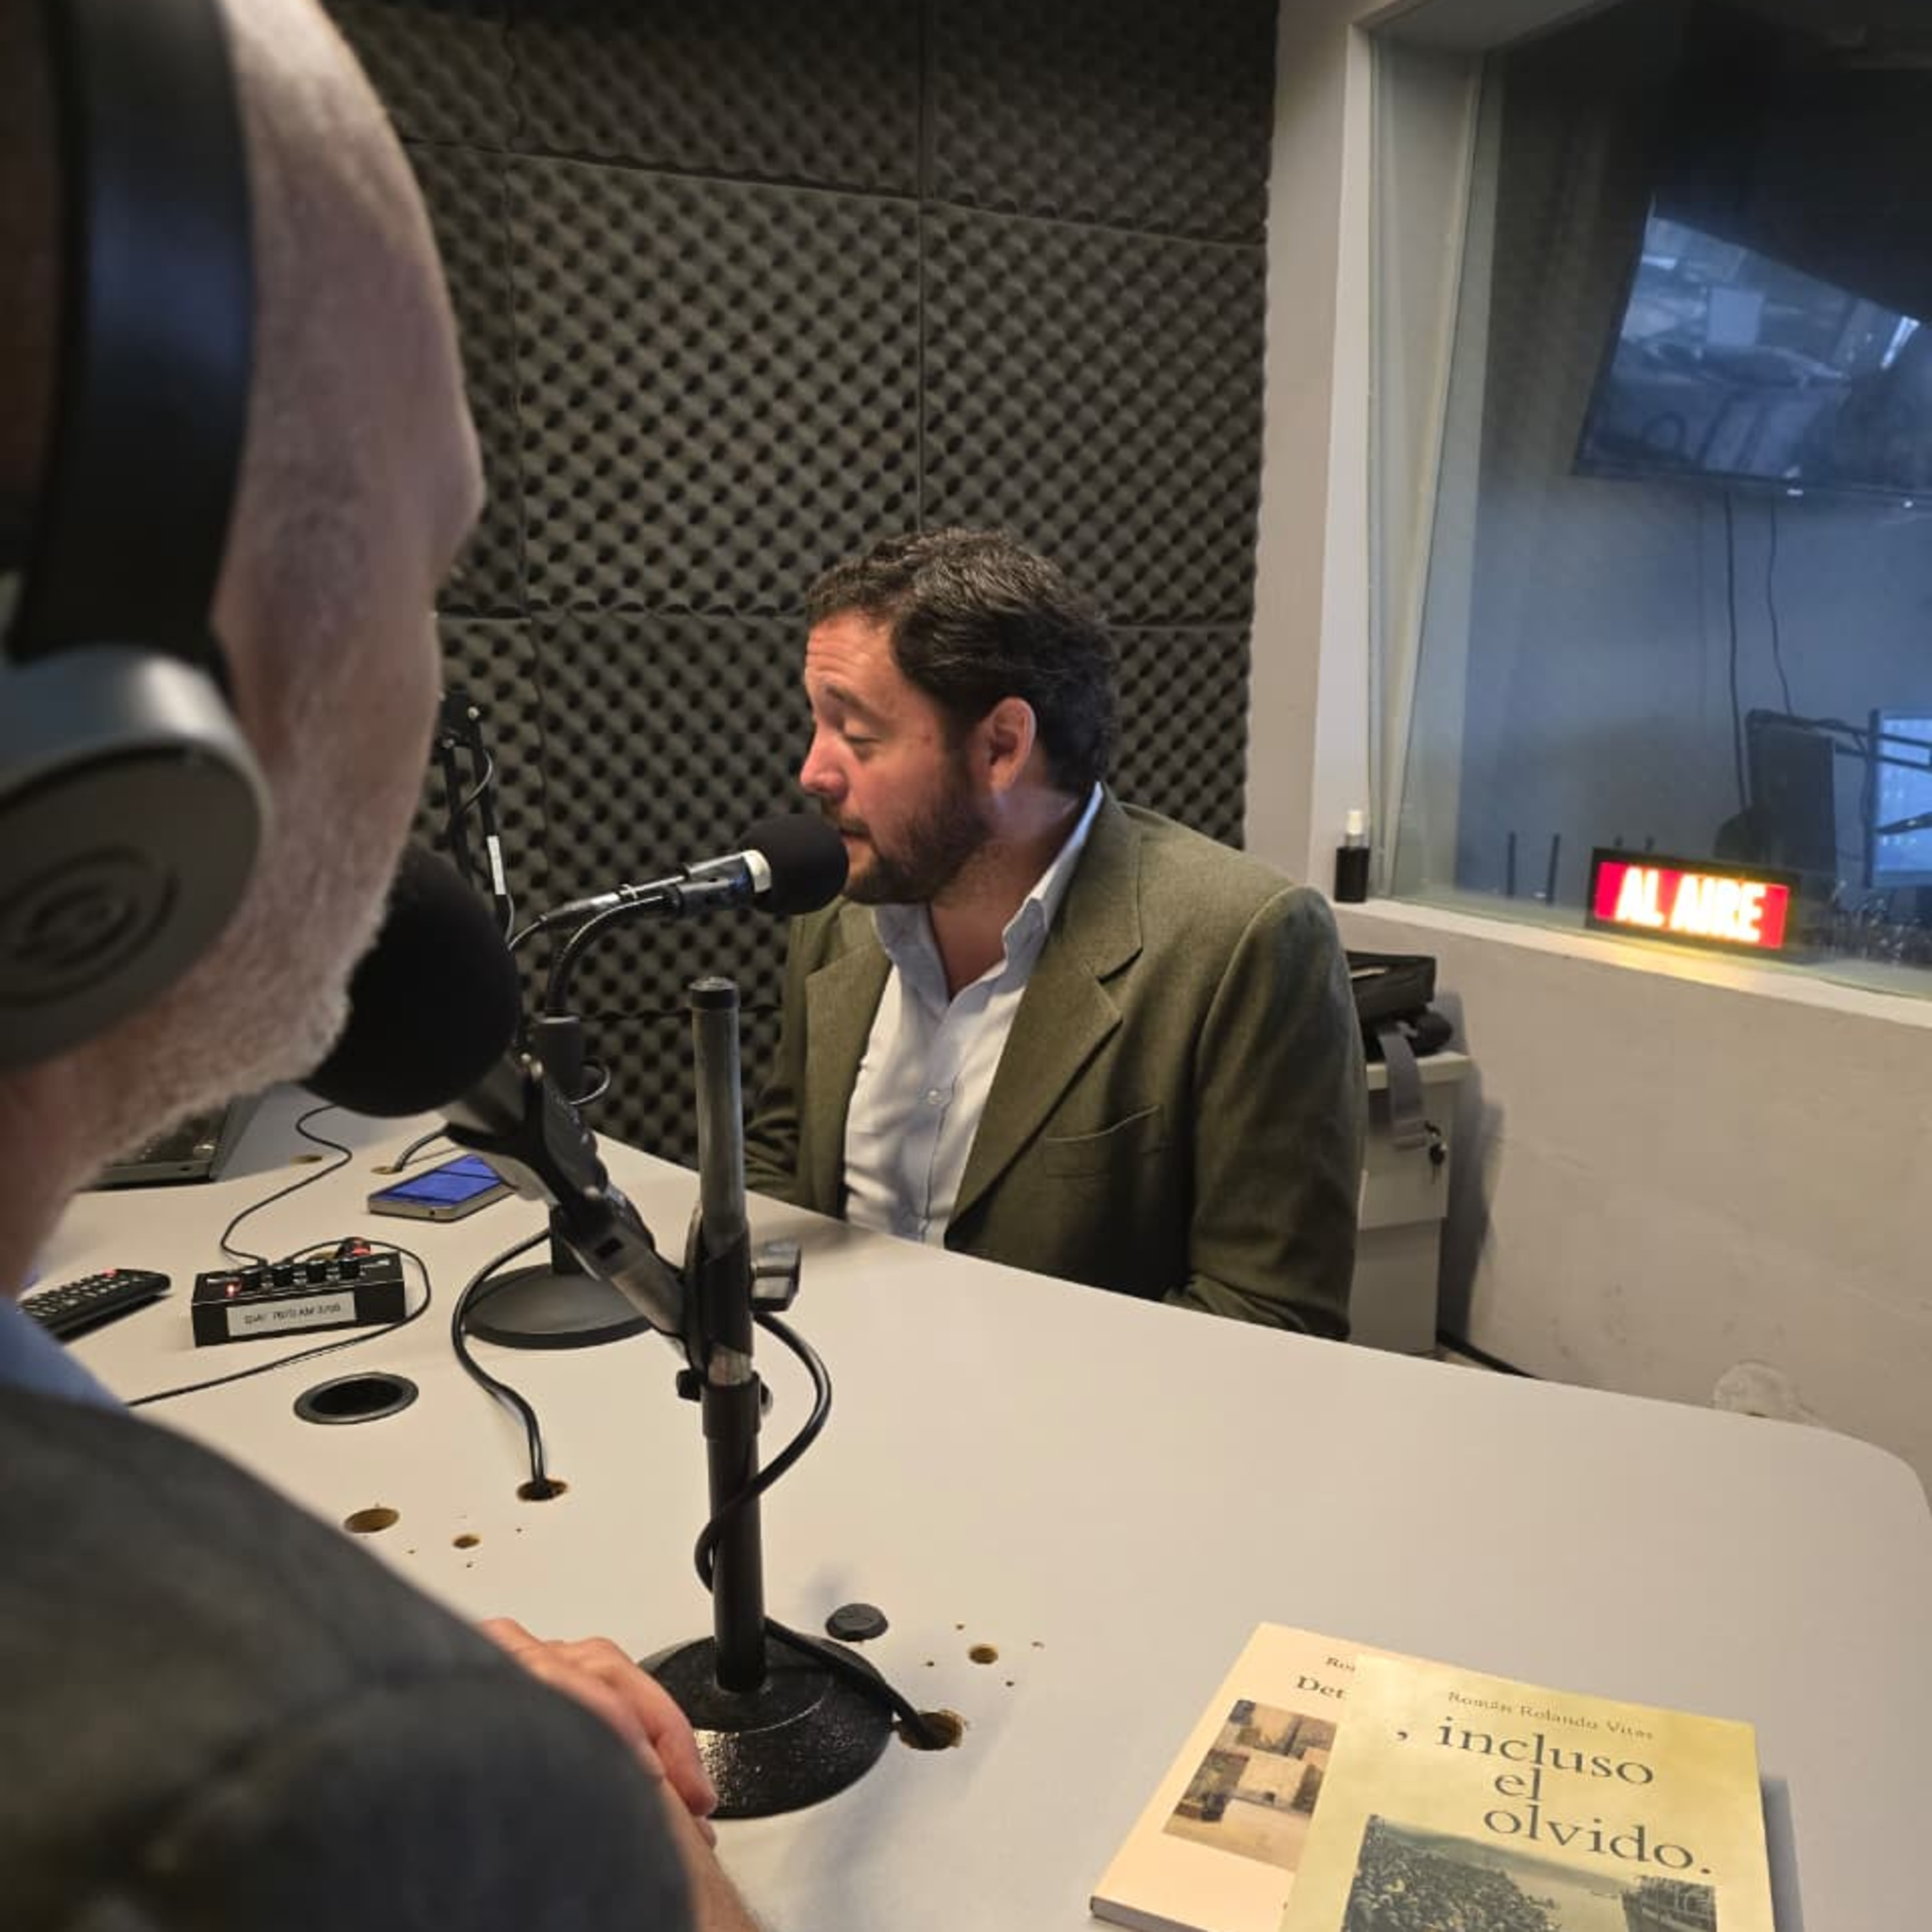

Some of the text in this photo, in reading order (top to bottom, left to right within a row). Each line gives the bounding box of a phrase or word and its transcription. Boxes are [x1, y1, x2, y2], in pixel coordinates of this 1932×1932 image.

[1615, 866, 1766, 943] AL AIRE
[1435, 1716, 1654, 1785] incluso
[1520, 1705, 1597, 1730] Rolando
[1494, 1767, 1543, 1801] el
[1484, 1804, 1710, 1874] olvido.
